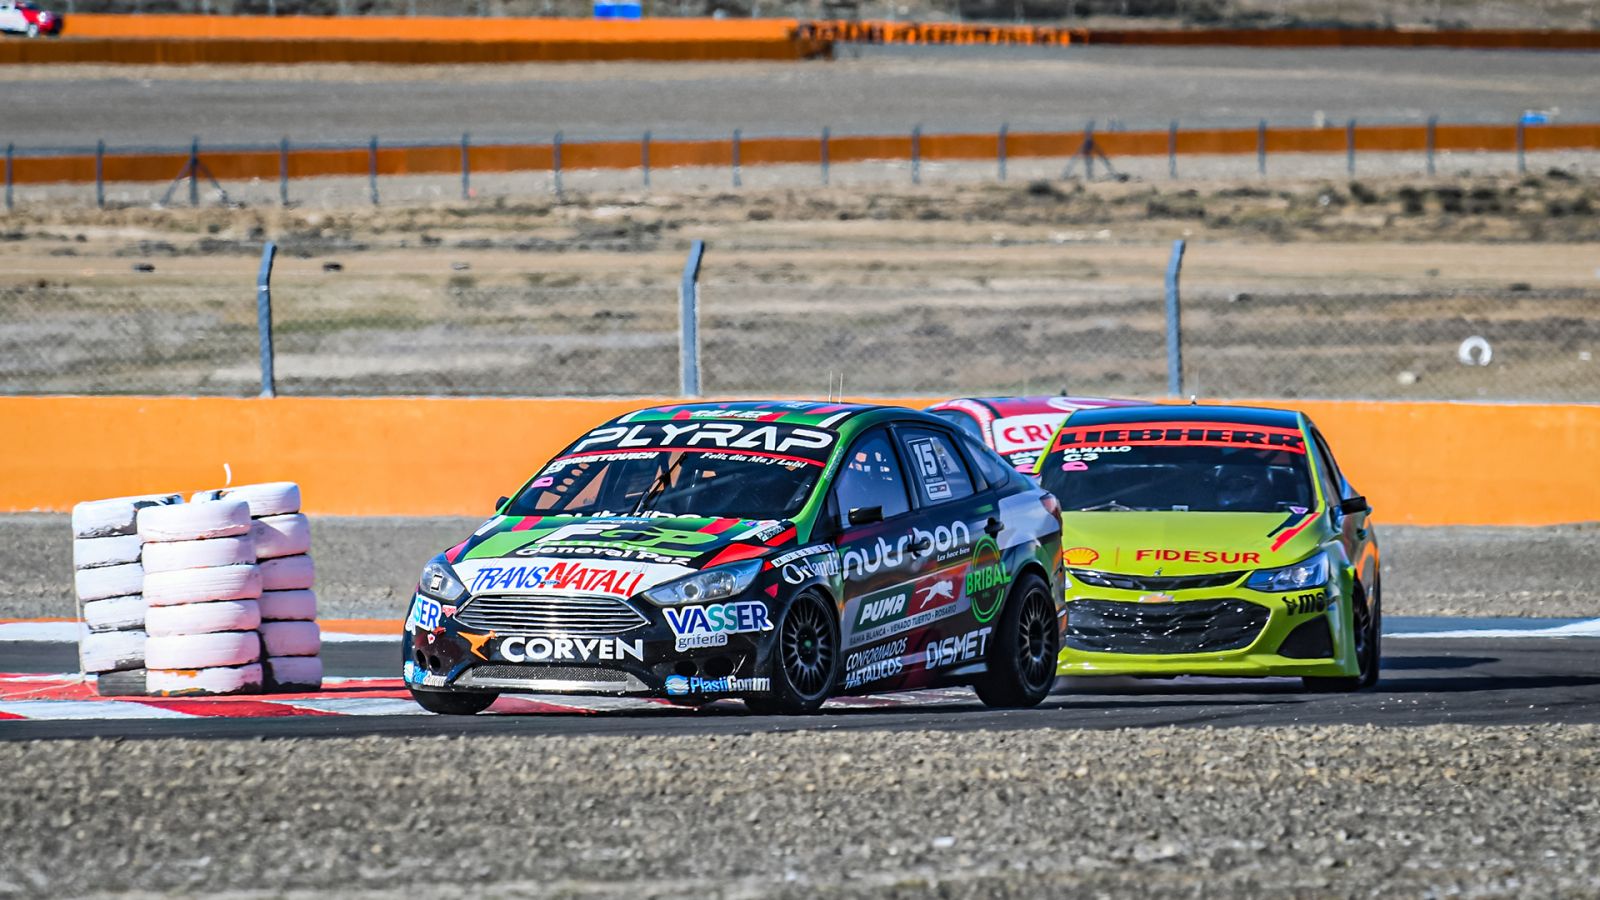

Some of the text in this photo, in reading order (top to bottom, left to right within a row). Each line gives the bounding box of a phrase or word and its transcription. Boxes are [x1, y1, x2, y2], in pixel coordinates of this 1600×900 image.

[573, 423, 833, 452] PLYRAP
[1059, 428, 1304, 447] LIEBHERR
[913, 443, 938, 477] 15
[515, 546, 634, 558] General
[635, 551, 692, 566] Paz
[782, 553, 840, 584] Orlandi
[1135, 549, 1261, 564] FIDESUR
[965, 560, 1012, 597] BRIBAL
[667, 603, 769, 635] VASSER
[859, 593, 906, 625] PUMA
[865, 628, 886, 641] BLANCA
[890, 620, 911, 633] VENADO
[911, 613, 932, 626] TUERTO
[934, 604, 957, 619] ROSARIO
[500, 636, 644, 663] CORVEN
[925, 626, 992, 670] DISMET
